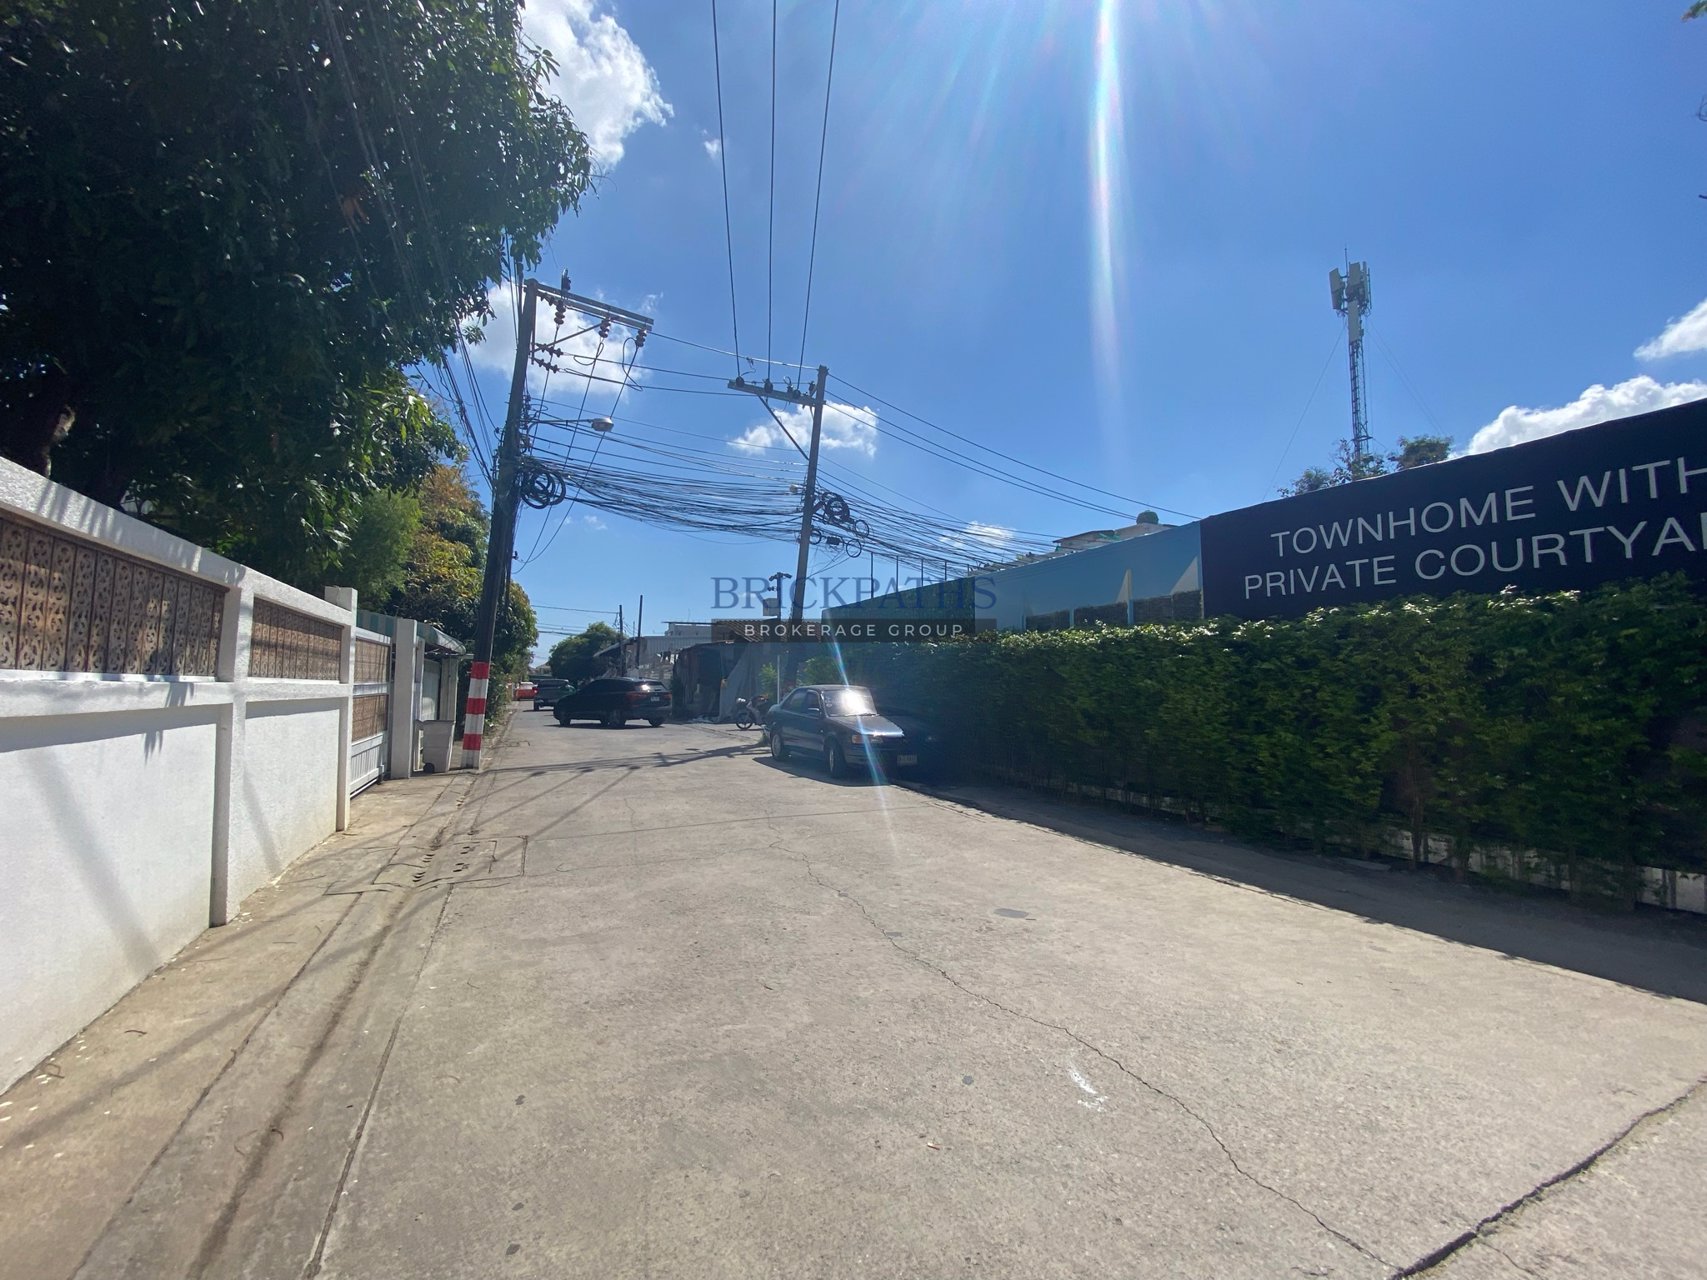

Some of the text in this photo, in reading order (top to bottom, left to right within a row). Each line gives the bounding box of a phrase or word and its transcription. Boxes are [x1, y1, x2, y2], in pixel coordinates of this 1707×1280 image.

[1271, 457, 1707, 557] TOWNHOME WITH
[1245, 513, 1707, 599] PRIVATE COURTYA
